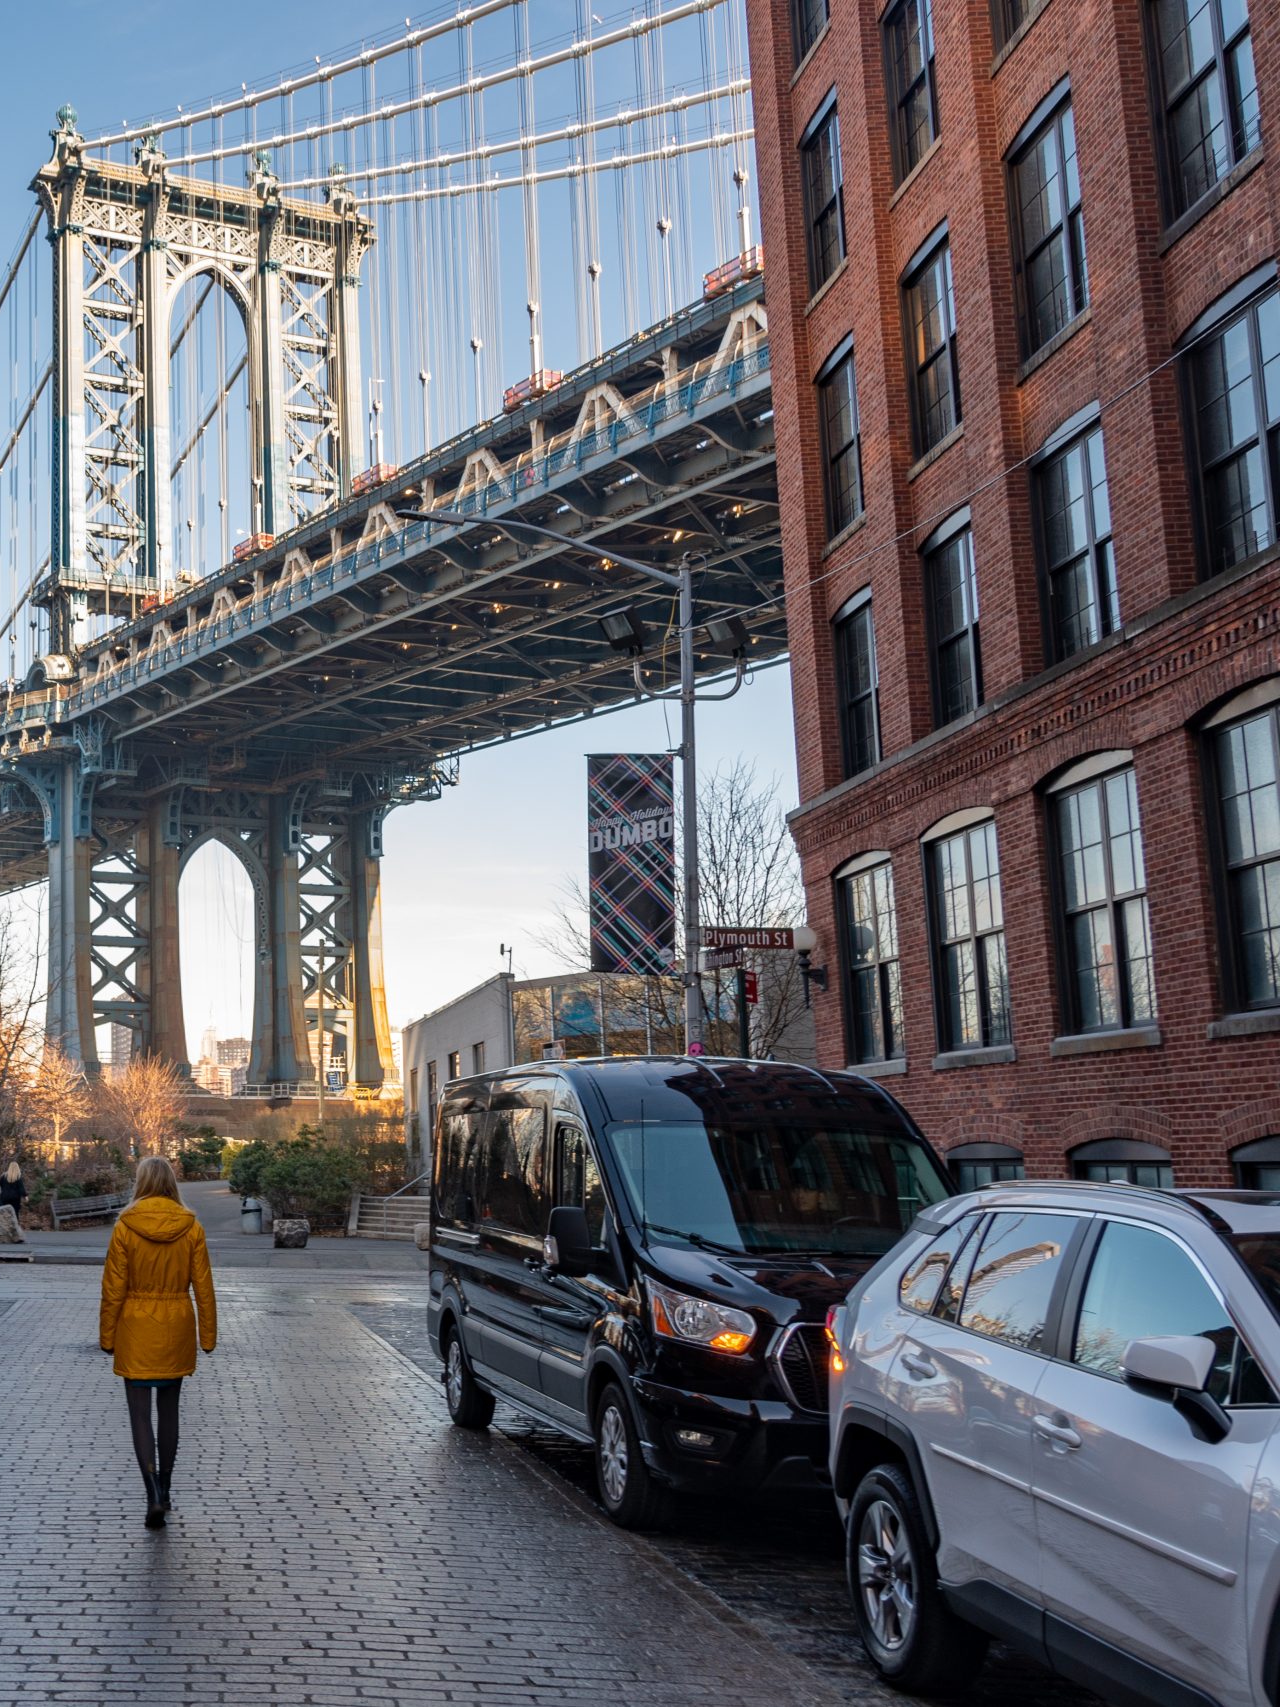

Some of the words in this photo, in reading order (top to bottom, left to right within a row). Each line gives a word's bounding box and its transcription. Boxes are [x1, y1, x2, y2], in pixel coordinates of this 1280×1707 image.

[589, 815, 624, 829] Happy
[630, 805, 673, 821] Holidays
[588, 816, 673, 853] DUMBO
[705, 929, 770, 947] Plymouth
[774, 931, 788, 946] St
[735, 948, 743, 963] St
